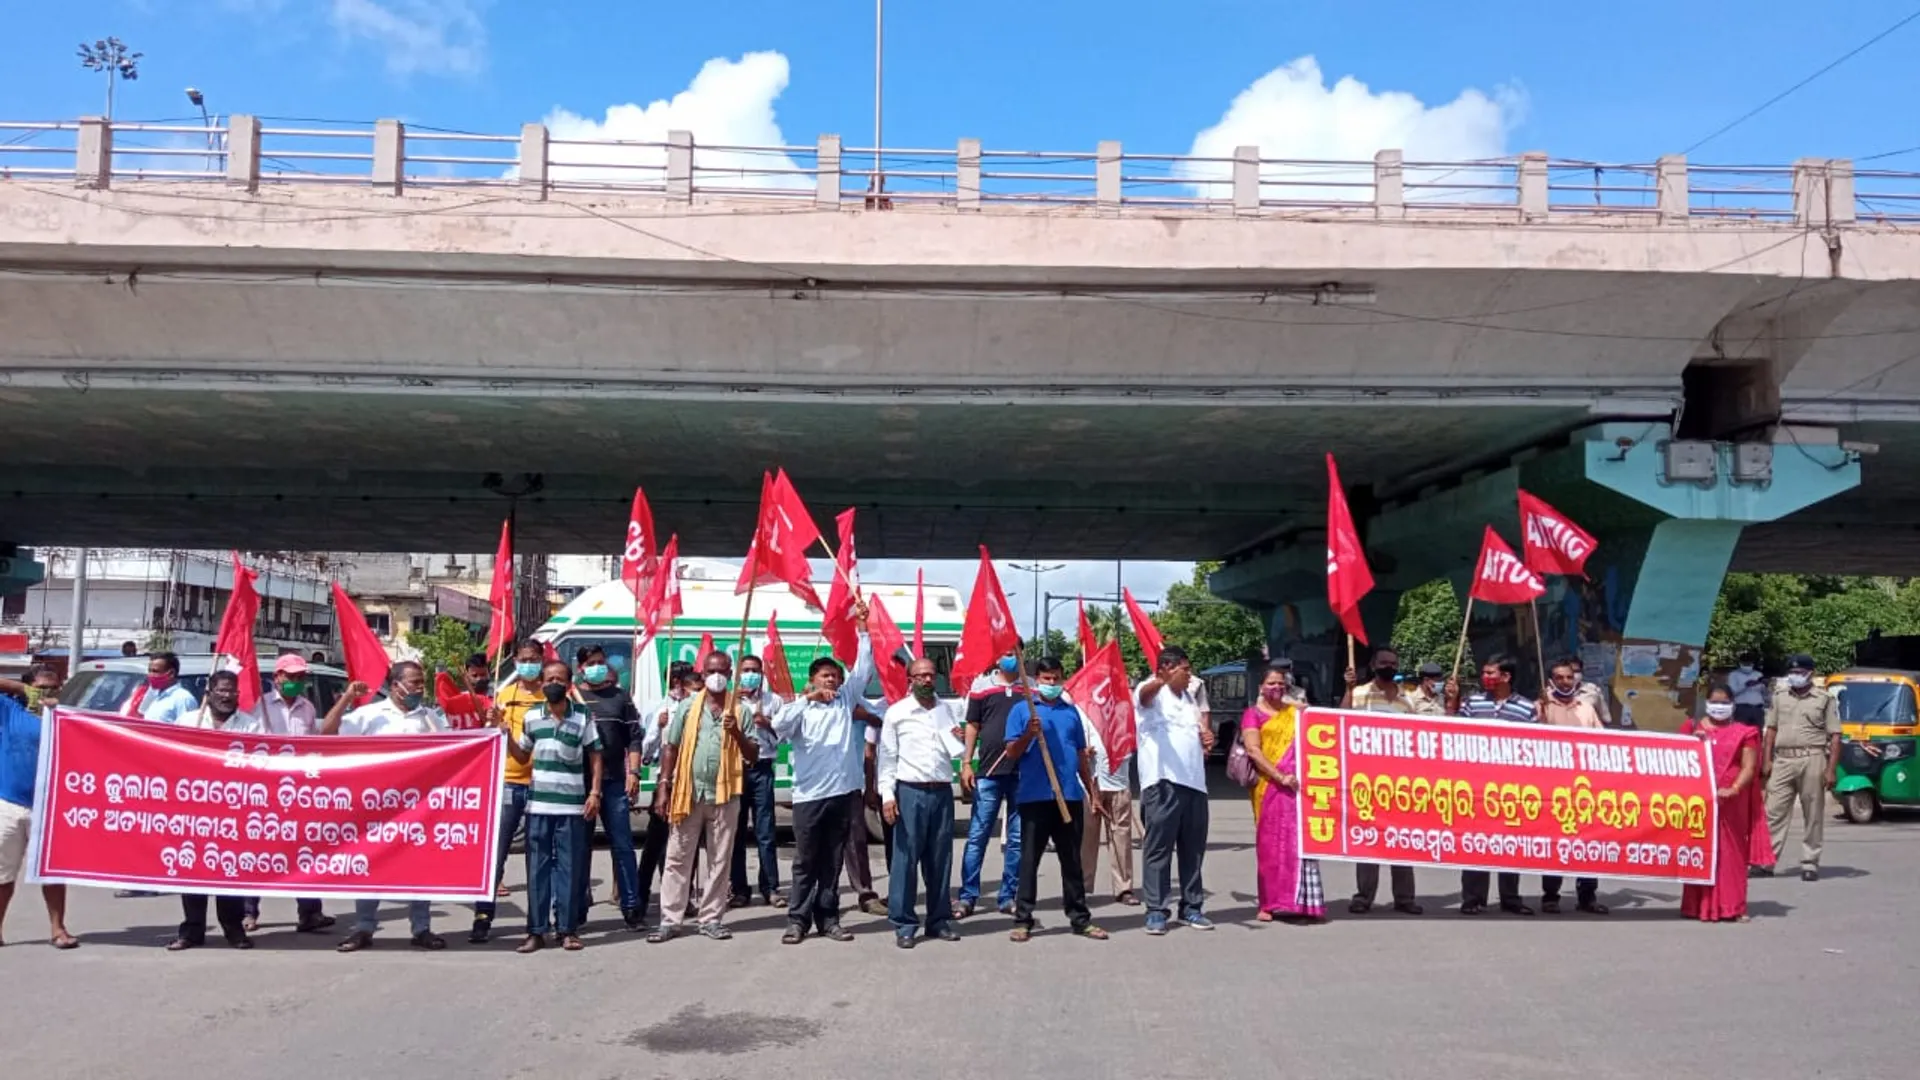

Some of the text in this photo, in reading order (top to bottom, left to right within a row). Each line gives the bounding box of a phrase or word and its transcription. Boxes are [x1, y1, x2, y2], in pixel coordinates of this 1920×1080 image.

[1349, 725, 1701, 778] CENTRE OF BHUBANESWAR TRADE UNIONS
[64, 771, 97, 795] ୧୫
[104, 773, 168, 804] ଜୁଲାଇ
[176, 778, 269, 809] ପେଟ୍ରୋଲ
[361, 786, 421, 811] ରନ୍ଧନ
[427, 785, 482, 810] ଗ୍ୟାସ
[1306, 724, 1340, 842] CBTU
[1351, 772, 1707, 838] ଭୁବନେଶ୍ୱର ଟ୍ରେଡ ୟୁନିୟନ କେନ୍ଦ୍ର
[63, 807, 480, 850] ଏବଂ ଅତ୍ୟାବଶ୍ୟକୀୟ ଜିନିଷ ପତ୍ରର ଅତ୍ୟନ୍ତ ମୂଲ୍ୟ
[1384, 826, 1456, 862] ନଭେମ୍ବର
[1461, 832, 1552, 860] ଦେଶବ୍ୟାପୀ
[1556, 838, 1621, 864] ହରତାଳ
[1626, 842, 1671, 866] ସଫଳ
[160, 841, 369, 877] ବୃଦ୍ଧି ବିରୁଦ୍ଧରେ ବିକ୍ଷୋଭ
